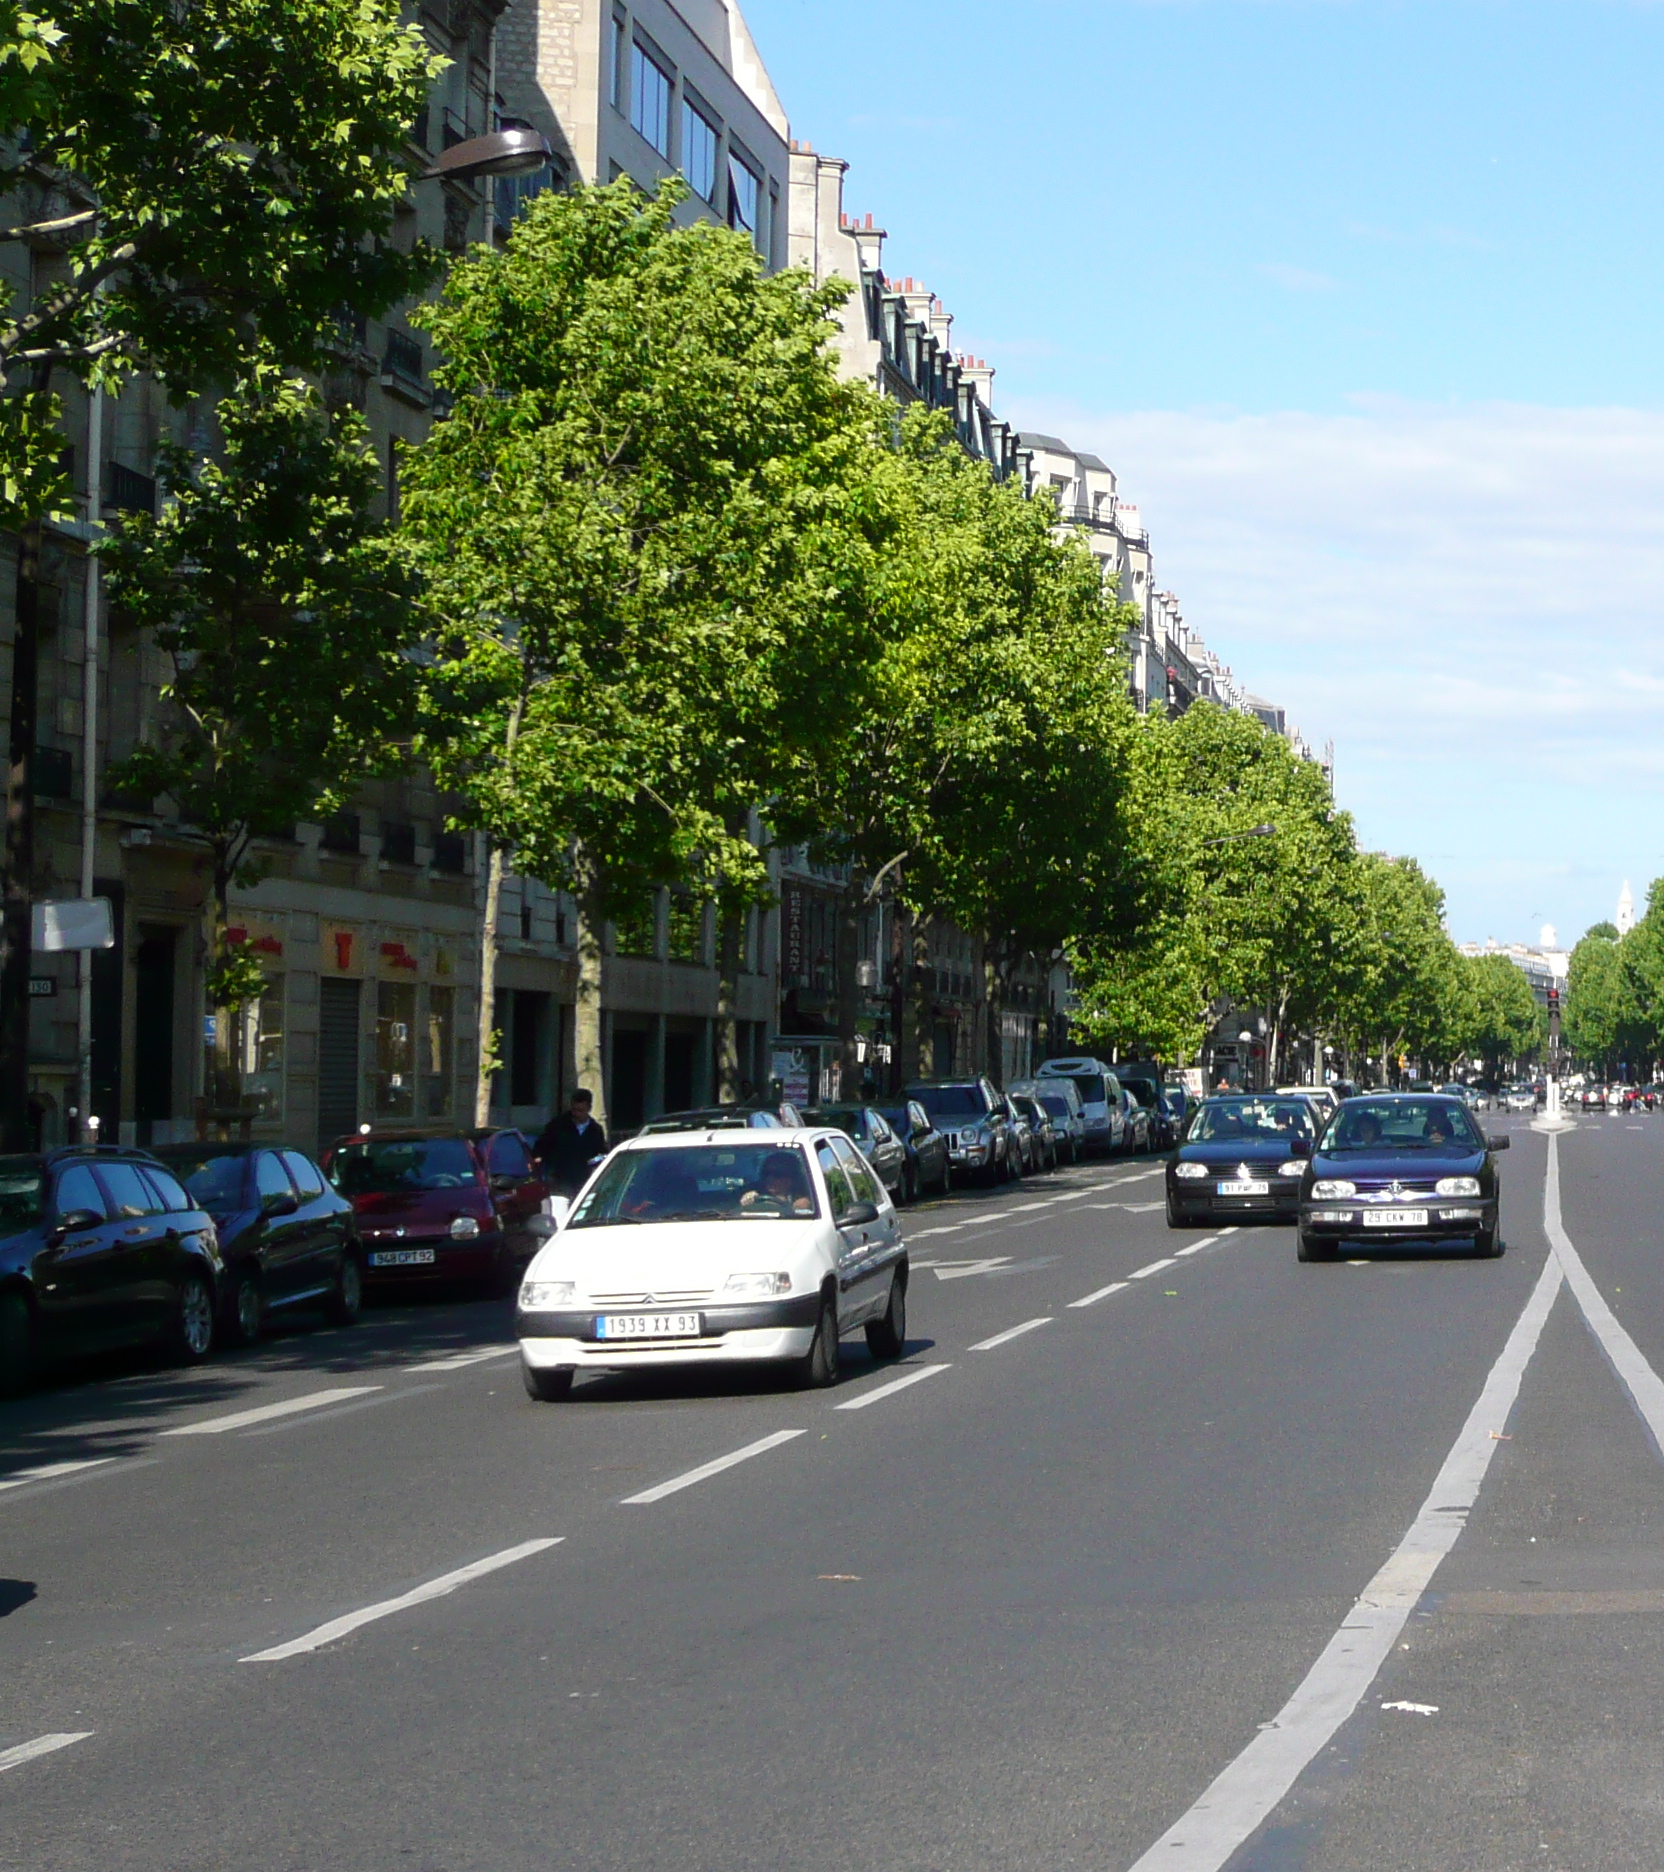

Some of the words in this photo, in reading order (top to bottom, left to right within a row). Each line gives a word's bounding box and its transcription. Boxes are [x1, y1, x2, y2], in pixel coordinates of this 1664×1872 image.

[788, 891, 802, 973] RESTAURANT
[1368, 1212, 1381, 1223] 29
[1386, 1212, 1405, 1223] CKW
[609, 1317, 646, 1333] 1939
[653, 1316, 671, 1332] XX
[678, 1315, 696, 1331] 93
